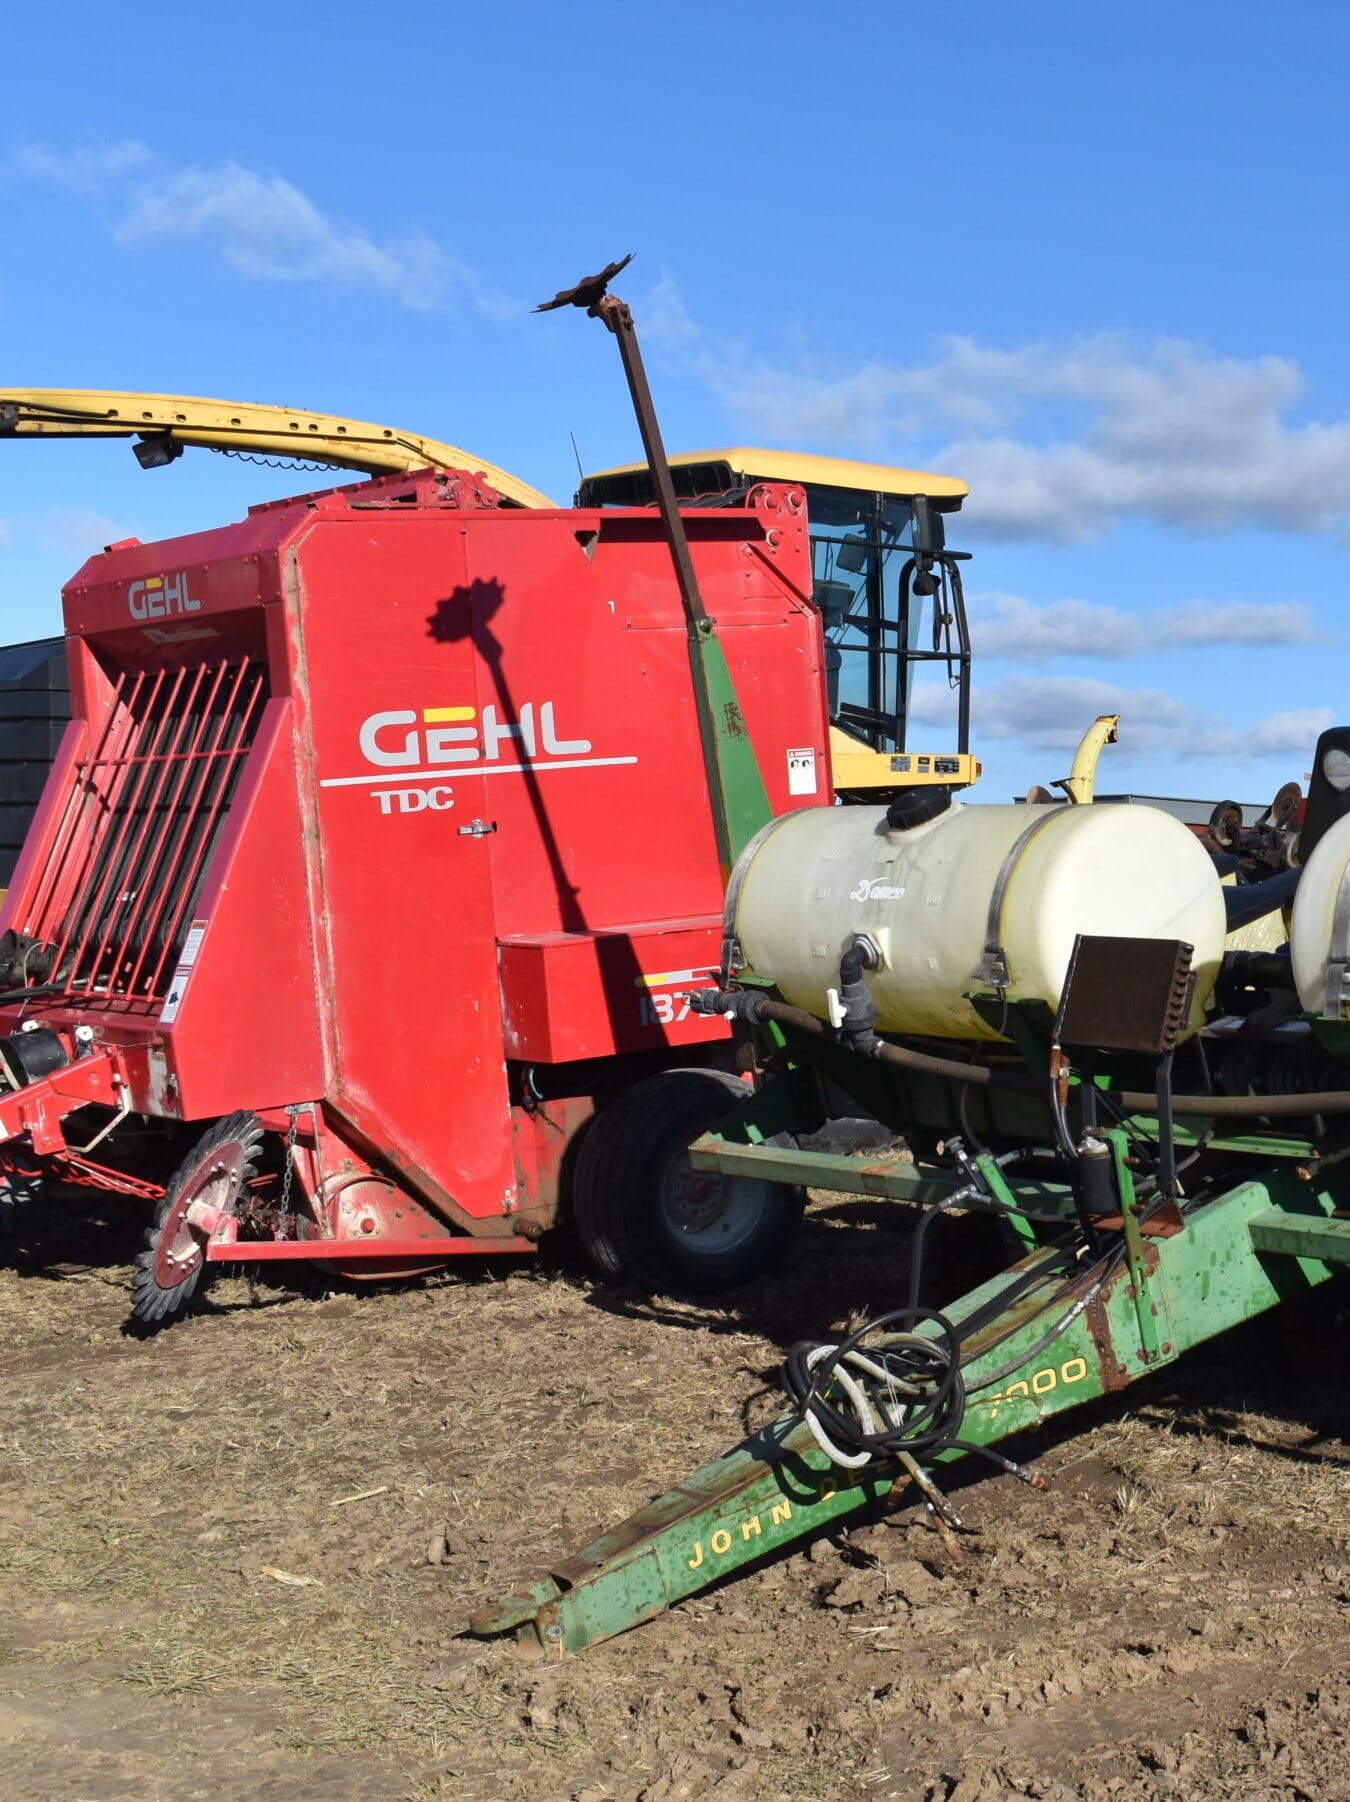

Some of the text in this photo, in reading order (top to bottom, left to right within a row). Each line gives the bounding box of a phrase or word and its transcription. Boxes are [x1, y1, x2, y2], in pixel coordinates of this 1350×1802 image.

[128, 572, 201, 619] GEHL
[359, 701, 592, 767] GEHL
[370, 786, 455, 815] TDC
[688, 1498, 793, 1569] JOHN
